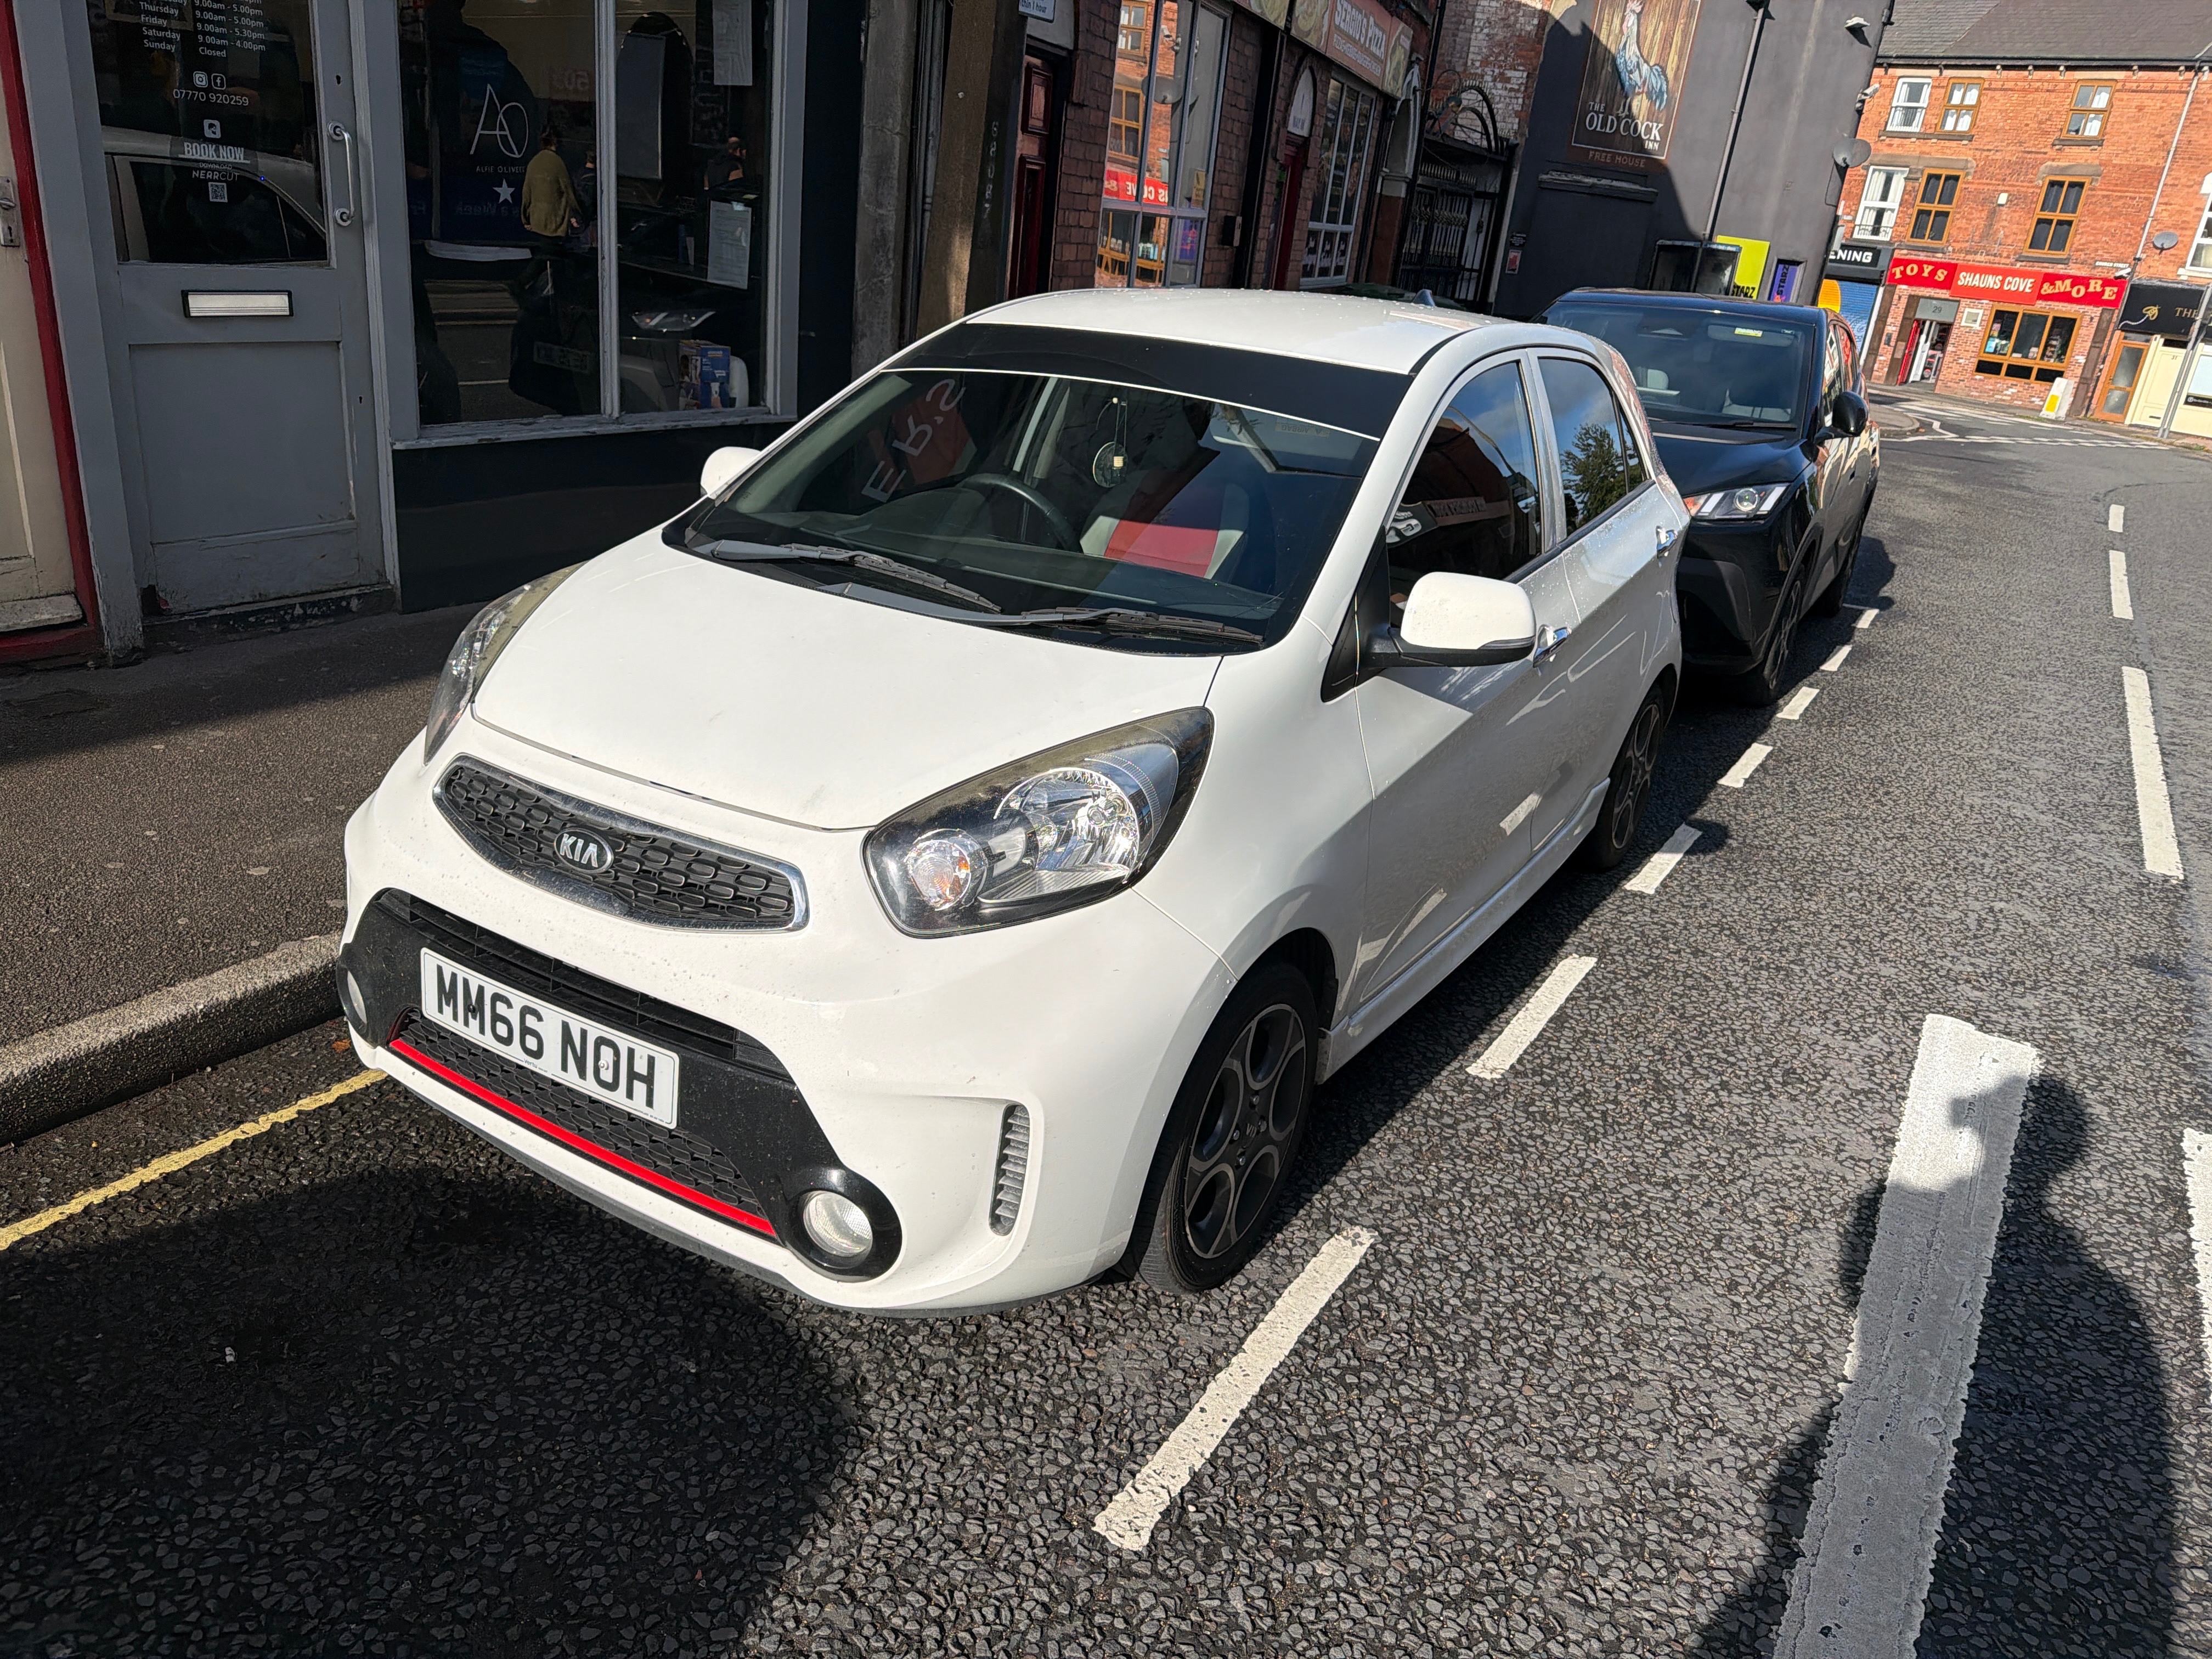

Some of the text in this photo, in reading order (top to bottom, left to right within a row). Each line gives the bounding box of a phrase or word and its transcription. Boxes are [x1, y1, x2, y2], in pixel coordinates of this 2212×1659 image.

[139, 2, 179, 16] Thursday
[195, 10, 226, 22] 9.00am
[234, 16, 264, 28] 5.00pm
[233, 4, 263, 16] 5.00pm
[141, 14, 167, 27] Friday
[196, 22, 227, 34] 9.00am
[235, 28, 265, 39] 5.30pm
[142, 27, 180, 41] Saturday
[198, 35, 228, 46] 9.00am
[235, 40, 266, 52] 4.00pm
[1366, 15, 1386, 59] PIZZA
[144, 40, 227, 58] Sunday Closed
[173, 89, 249, 106] 07770 920259
[1589, 101, 1605, 112] THE
[1585, 112, 1664, 141] OLD COCK
[184, 142, 244, 161] BOOK NOW
[1644, 140, 1660, 151] INN
[1588, 150, 1646, 167] FREE HOUSE
[192, 170, 240, 180] NEARCUT
[1777, 264, 1790, 295] STARZ
[1891, 263, 1948, 282] TOYS
[1958, 272, 2035, 293] SHAUNS COVE
[560, 833, 599, 868] KIA
[436, 963, 656, 1110] MM66 NOH
[524, 1058, 538, 1069] Vertu
